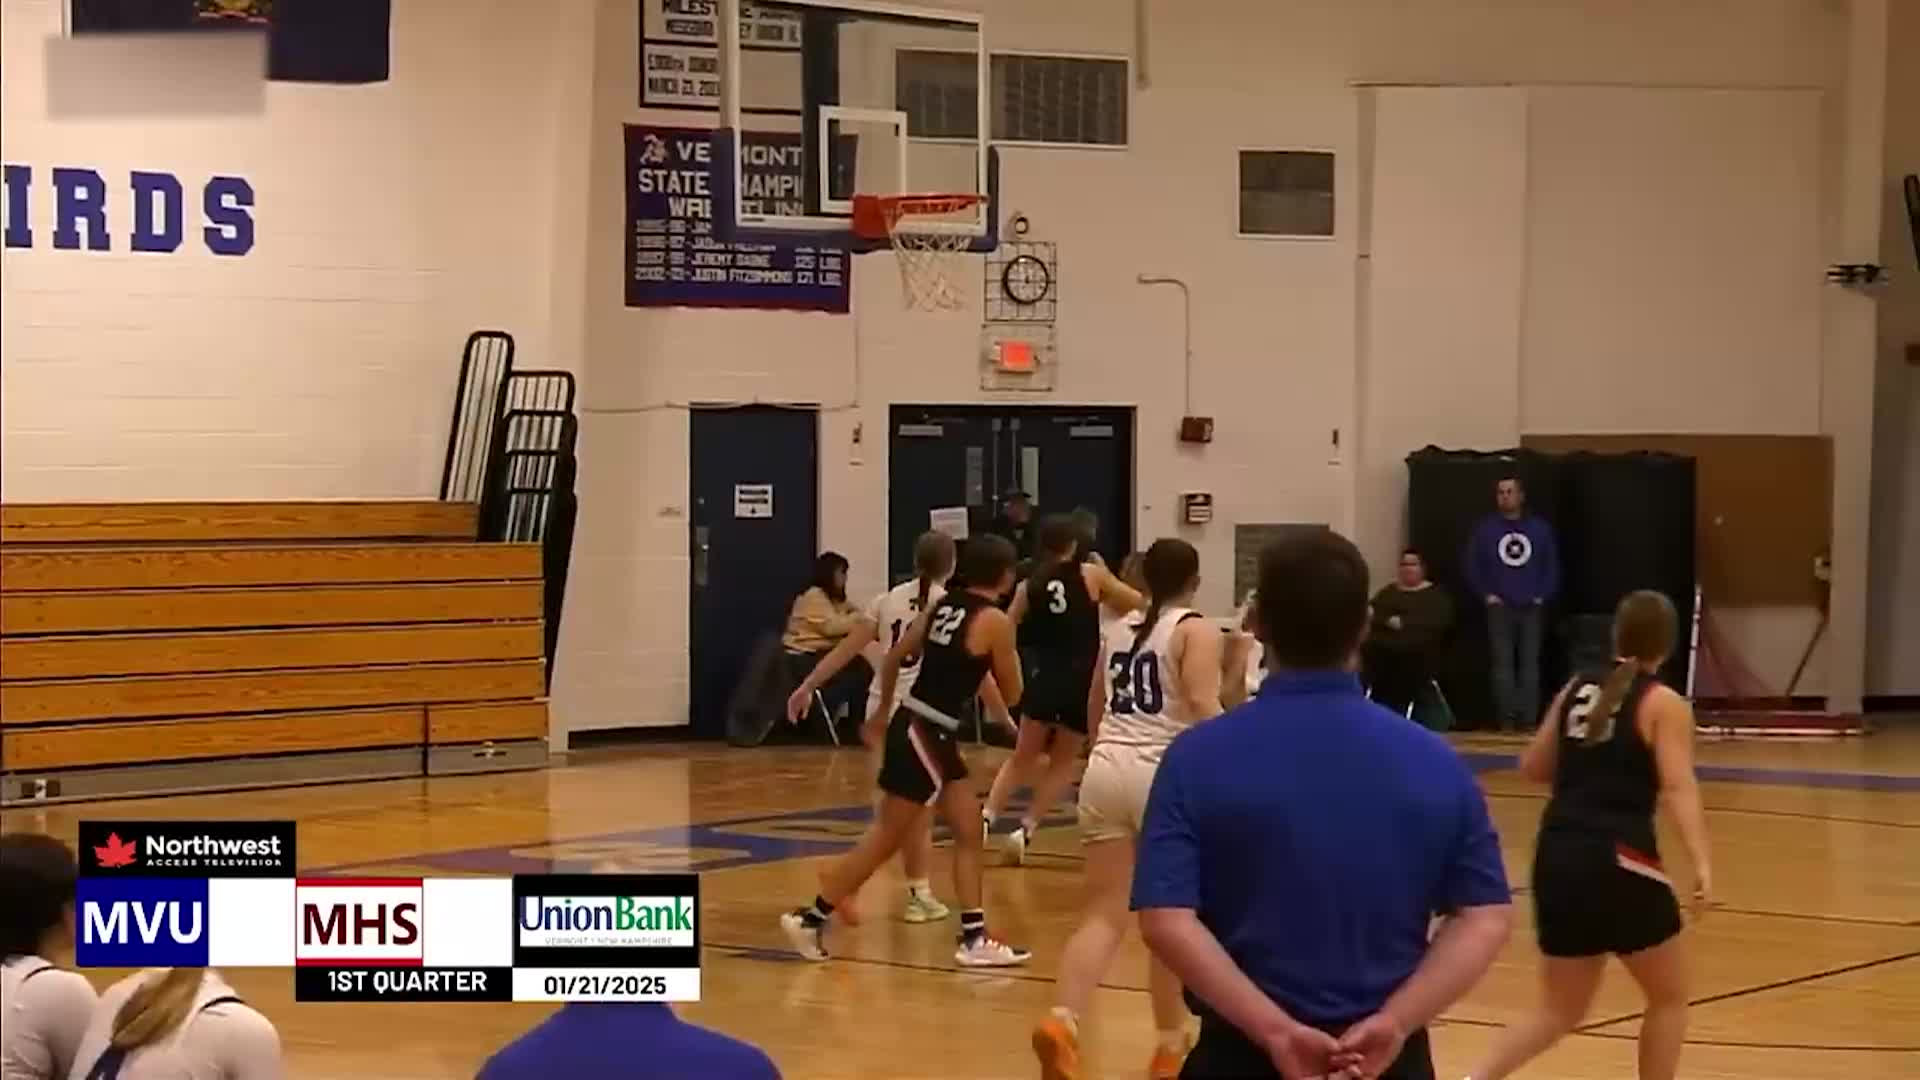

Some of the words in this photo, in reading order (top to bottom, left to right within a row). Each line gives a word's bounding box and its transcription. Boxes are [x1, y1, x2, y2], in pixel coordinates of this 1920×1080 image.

[638, 168, 711, 195] STATE
[1047, 579, 1067, 614] 3
[928, 605, 967, 646] 22
[1109, 650, 1163, 714] 20
